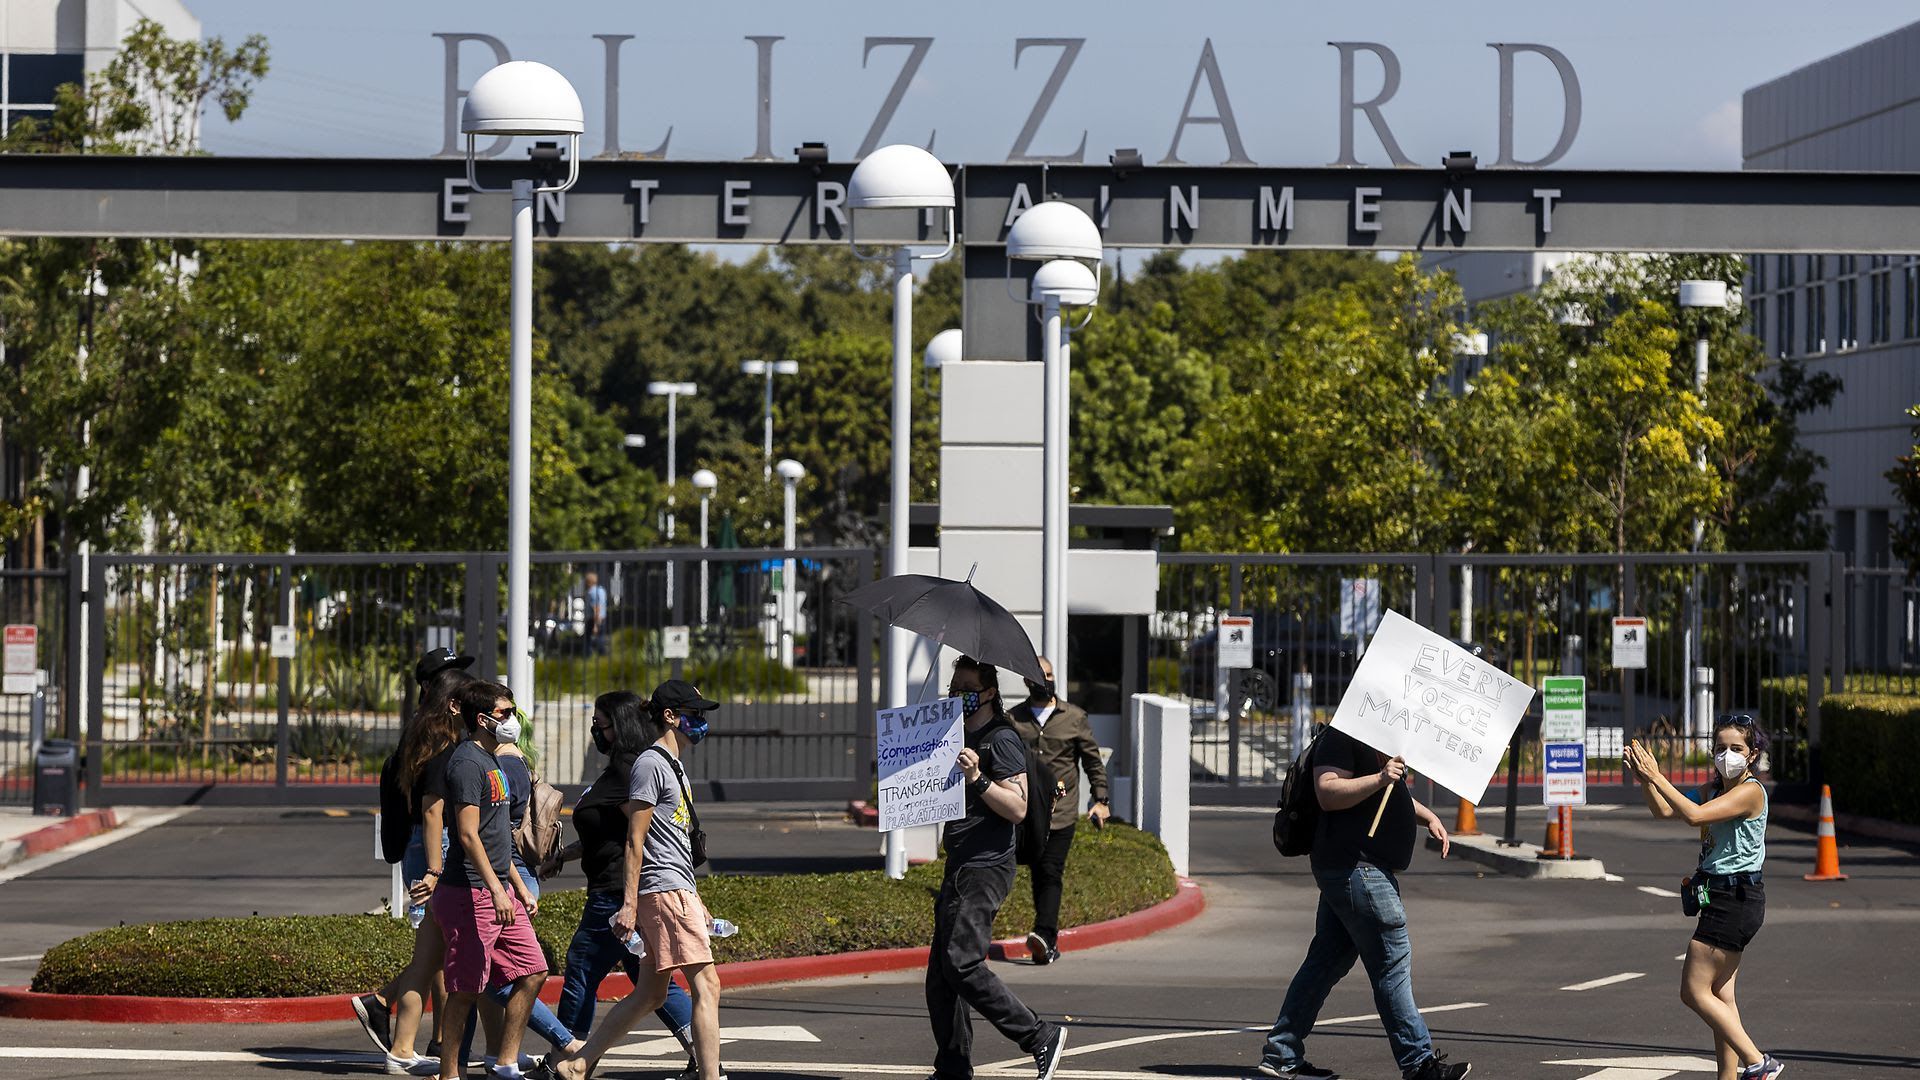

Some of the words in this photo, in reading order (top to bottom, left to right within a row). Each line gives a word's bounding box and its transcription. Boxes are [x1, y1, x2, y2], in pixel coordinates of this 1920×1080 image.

[431, 33, 1583, 169] BLIZZARD
[444, 178, 1561, 233] ENTERAINMENT
[1414, 643, 1512, 700] EVERY
[881, 713, 894, 737] I
[899, 701, 954, 729] WISH
[1403, 674, 1491, 736] VOICE
[1358, 692, 1482, 762] MATTERS
[882, 738, 949, 760] compensation
[1550, 748, 1579, 758] VISITORS
[880, 772, 964, 803] TRANSPARENT
[926, 765, 940, 778] as
[886, 802, 960, 830] PLACATION
